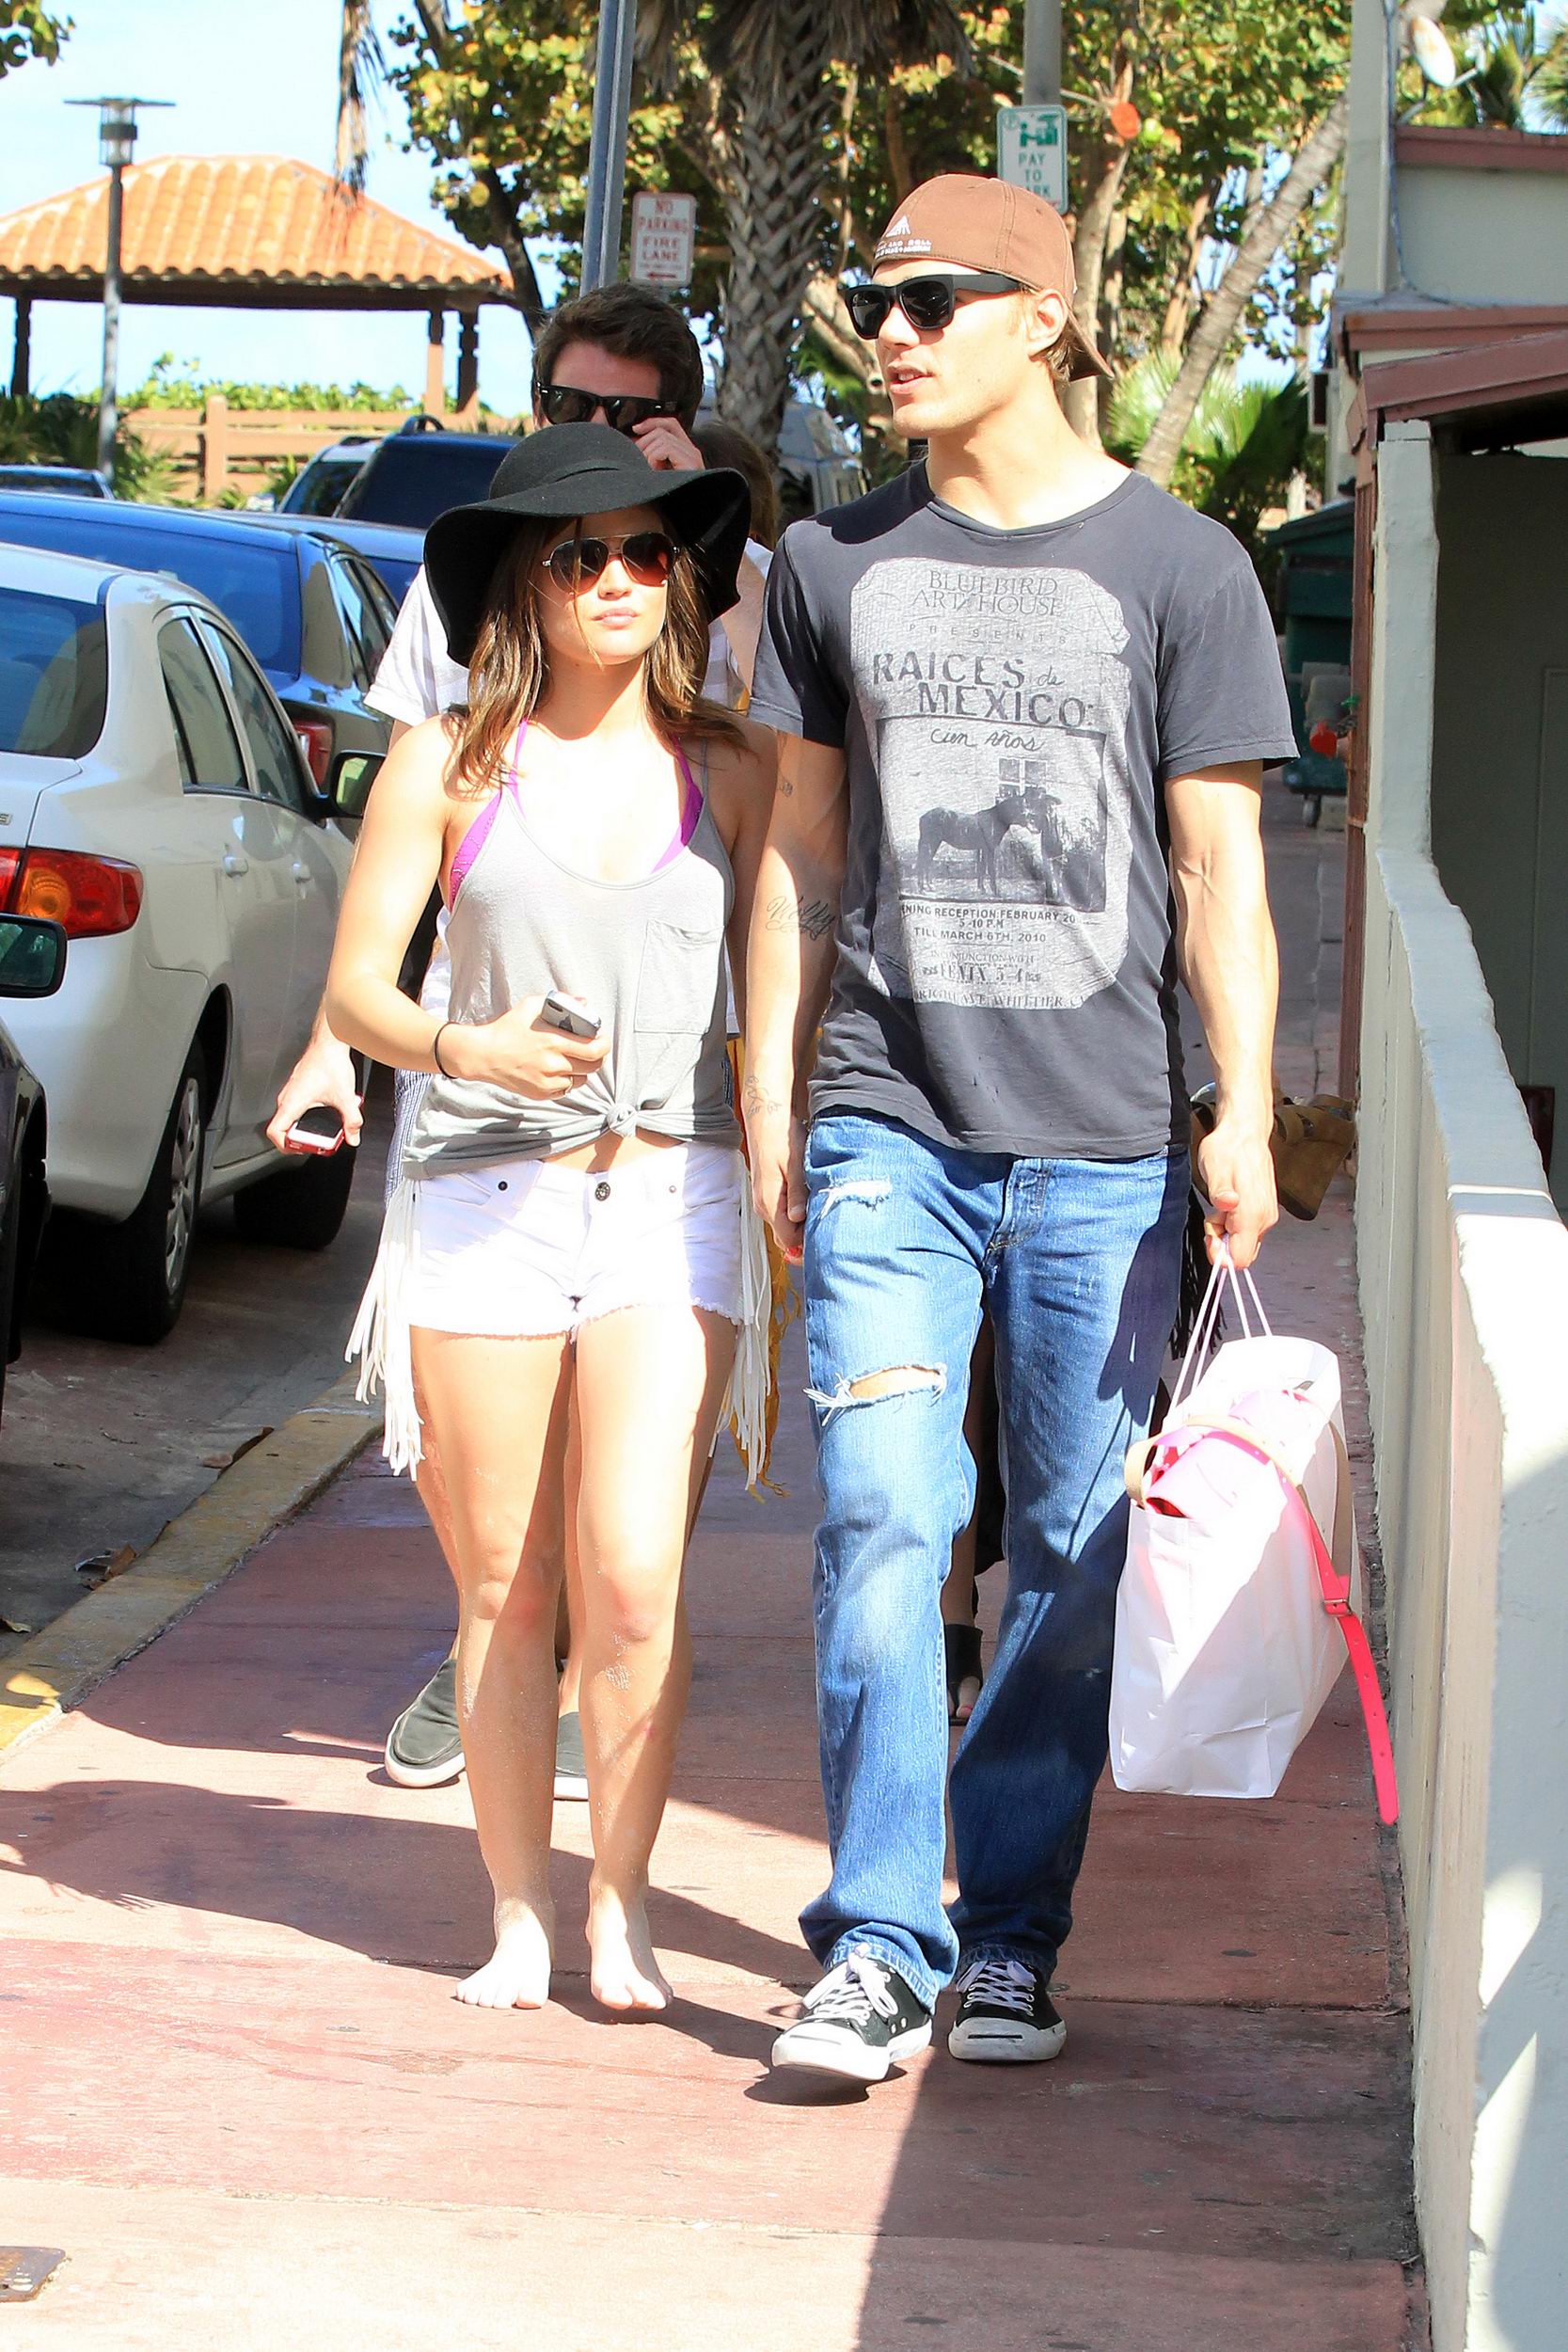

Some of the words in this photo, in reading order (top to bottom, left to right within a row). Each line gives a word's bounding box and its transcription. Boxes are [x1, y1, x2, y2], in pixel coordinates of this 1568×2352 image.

[1019, 153, 1045, 166] PAY
[1025, 170, 1042, 183] TO
[656, 199, 673, 215] NO
[639, 216, 688, 234] PARKING
[642, 236, 679, 248] FIRE
[642, 250, 679, 262] LANE
[929, 570, 1058, 596] BLUEBIRD
[978, 595, 1063, 616] HOUSE
[873, 651, 1025, 689] RAICES
[1037, 665, 1065, 687] de
[1000, 909, 1059, 921] FEBRUARY
[914, 927, 937, 938] TILL
[941, 930, 983, 941] MARCH
[1018, 932, 1047, 942] 2010
